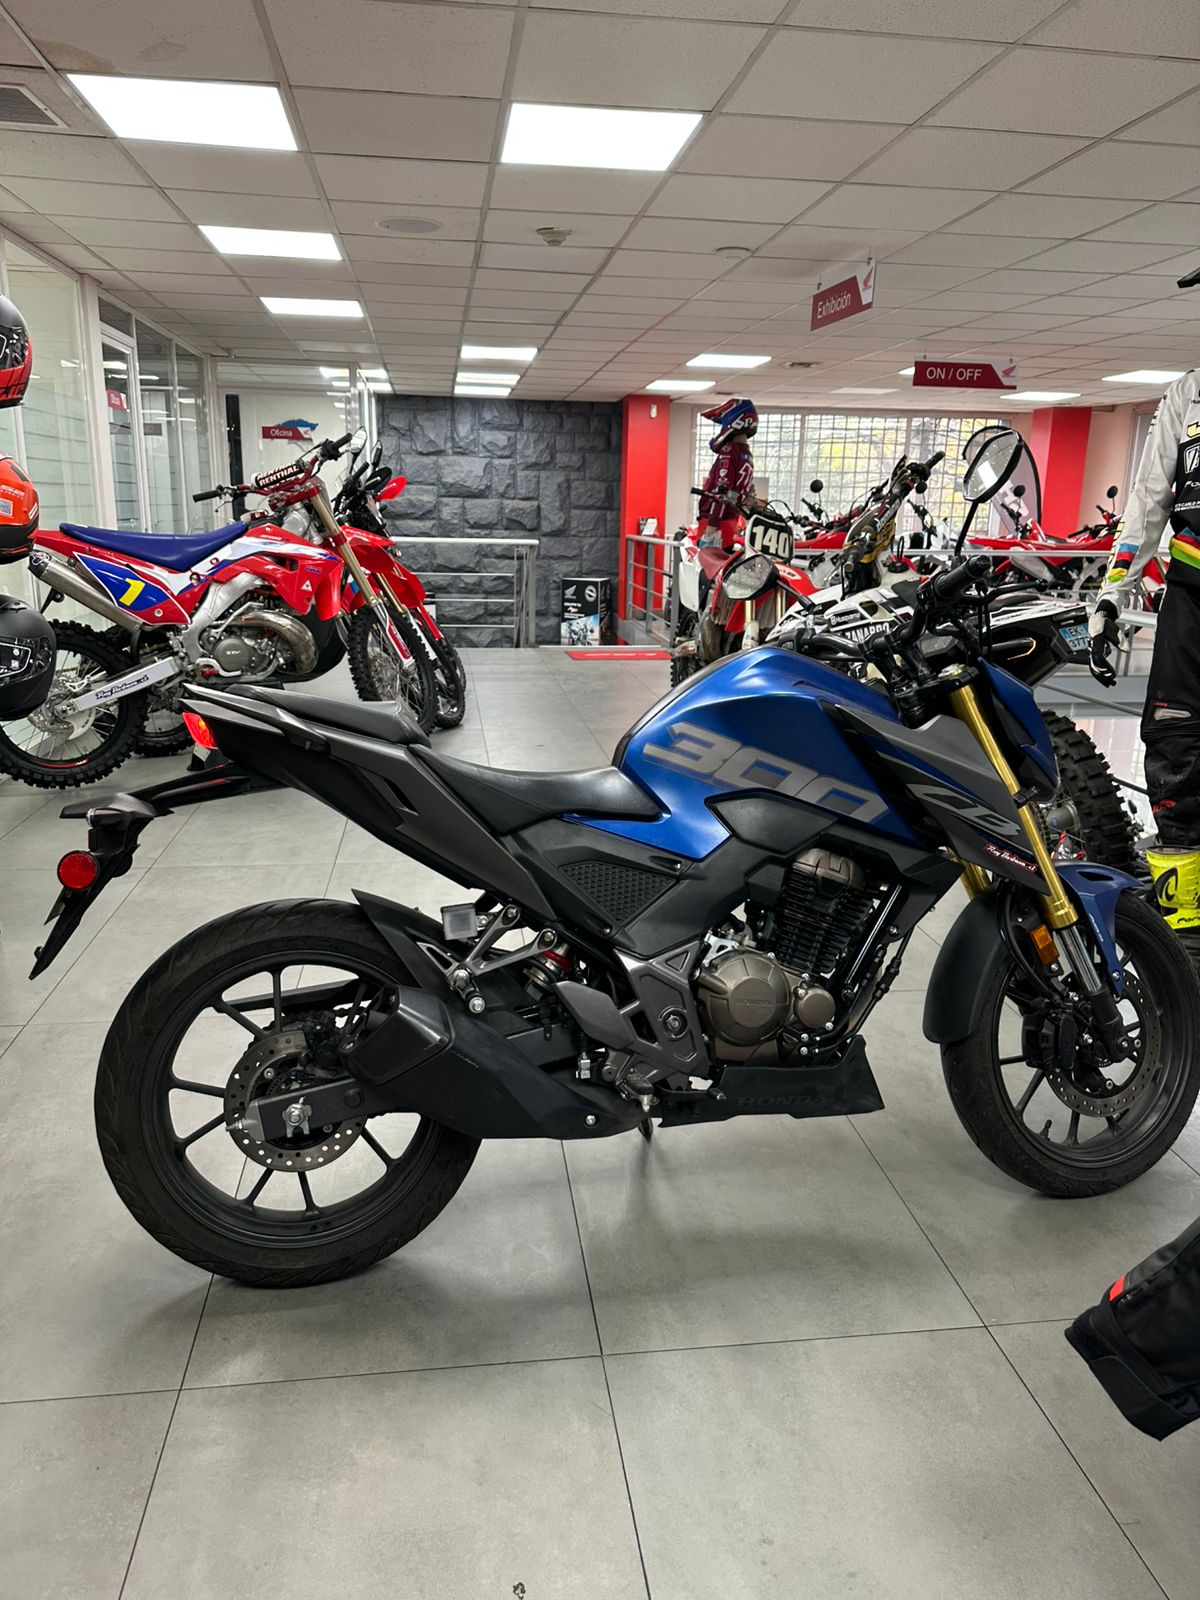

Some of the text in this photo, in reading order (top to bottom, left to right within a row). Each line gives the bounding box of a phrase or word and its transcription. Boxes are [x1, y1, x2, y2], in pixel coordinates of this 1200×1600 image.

[817, 291, 851, 319] Exhibición
[926, 367, 982, 381] ON / OFF
[270, 428, 293, 437] Oficina
[259, 465, 300, 487] RENTHAL
[752, 525, 790, 559] 140
[119, 578, 146, 606] 1
[643, 721, 889, 823] 300
[905, 783, 1021, 835] CB
